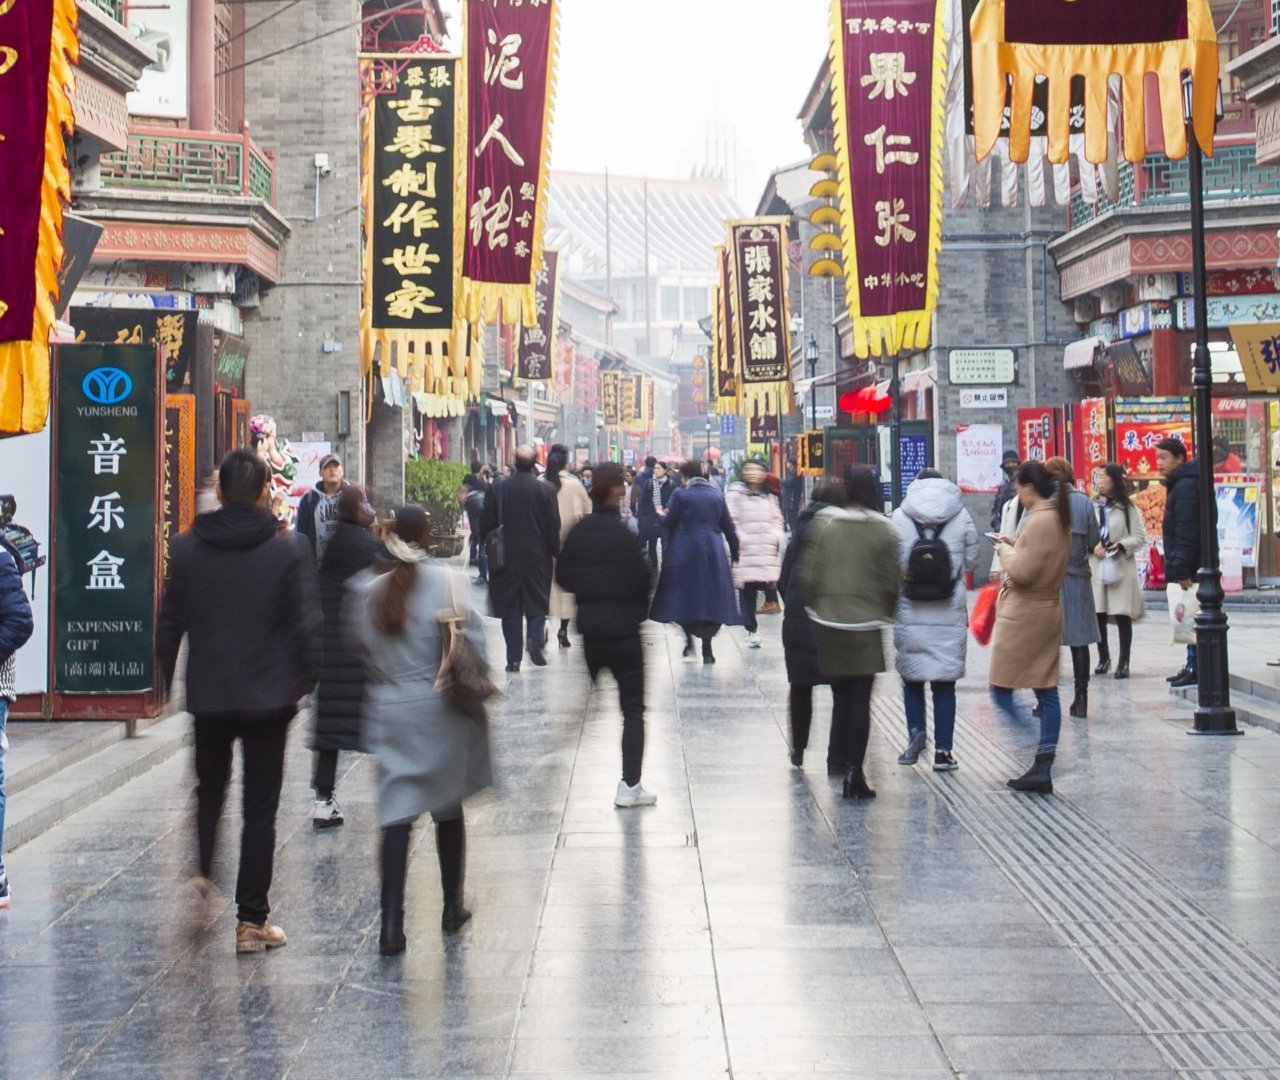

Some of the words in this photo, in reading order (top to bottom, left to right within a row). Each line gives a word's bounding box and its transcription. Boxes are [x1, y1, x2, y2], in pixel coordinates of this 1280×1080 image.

[861, 52, 919, 247] 果仁张
[381, 88, 445, 320] 古琴制作世家
[77, 406, 138, 417] YUNSHENG
[85, 433, 127, 590] 音乐盒
[66, 639, 100, 651] GIFT
[67, 621, 143, 633] EXPENSIVE
